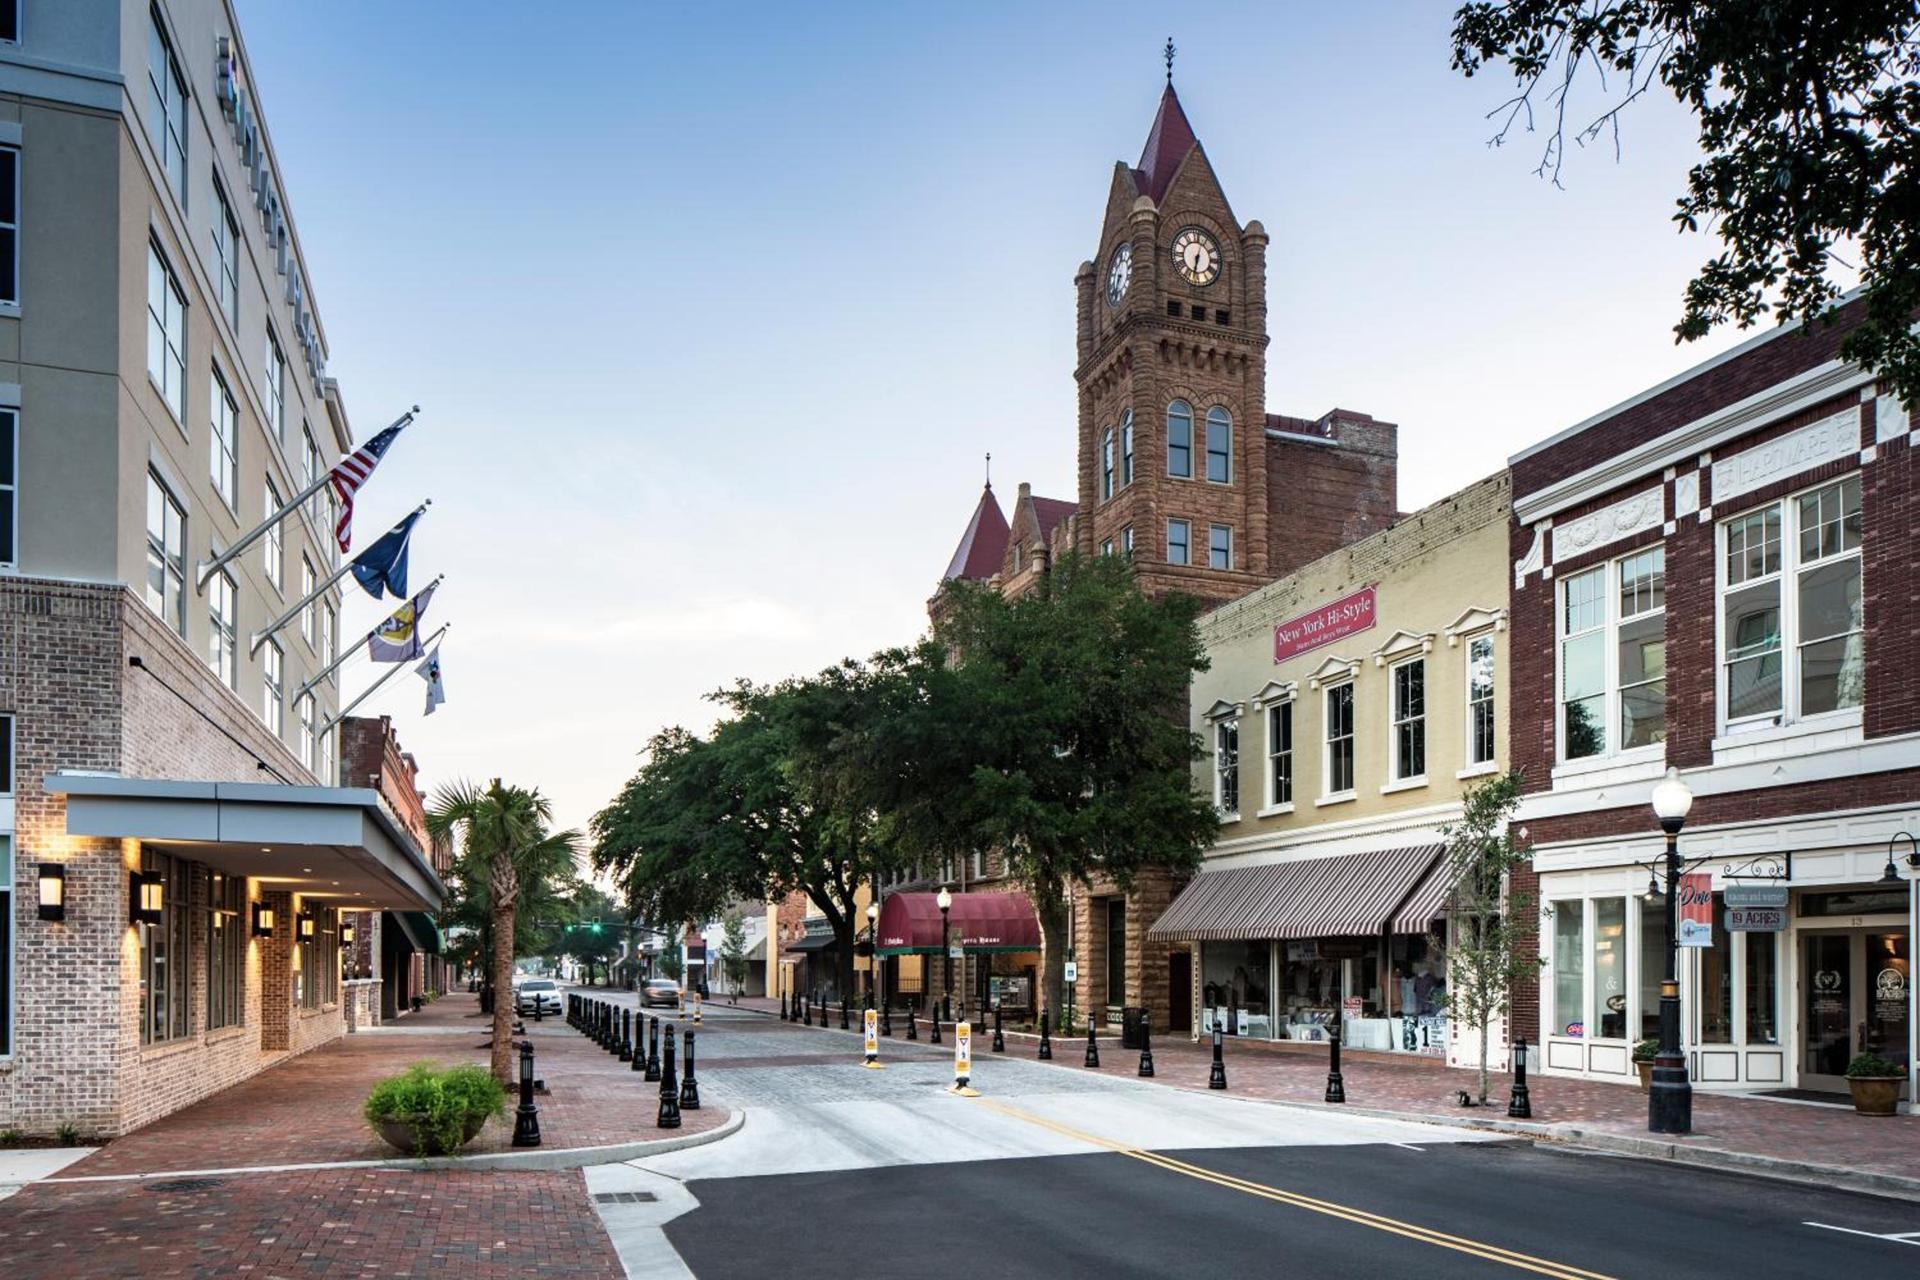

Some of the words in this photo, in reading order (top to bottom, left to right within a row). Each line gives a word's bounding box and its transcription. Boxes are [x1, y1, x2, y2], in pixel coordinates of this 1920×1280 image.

[1739, 430, 1831, 485] HARDWARE
[1279, 629, 1300, 646] New
[1303, 615, 1326, 635] York
[1327, 597, 1371, 625] Hi-Style
[1681, 885, 1710, 906] Dine
[1732, 911, 1743, 923] 19
[1745, 911, 1780, 924] ACRES
[1605, 975, 1617, 991] &
[1422, 1025, 1429, 1047] 1
